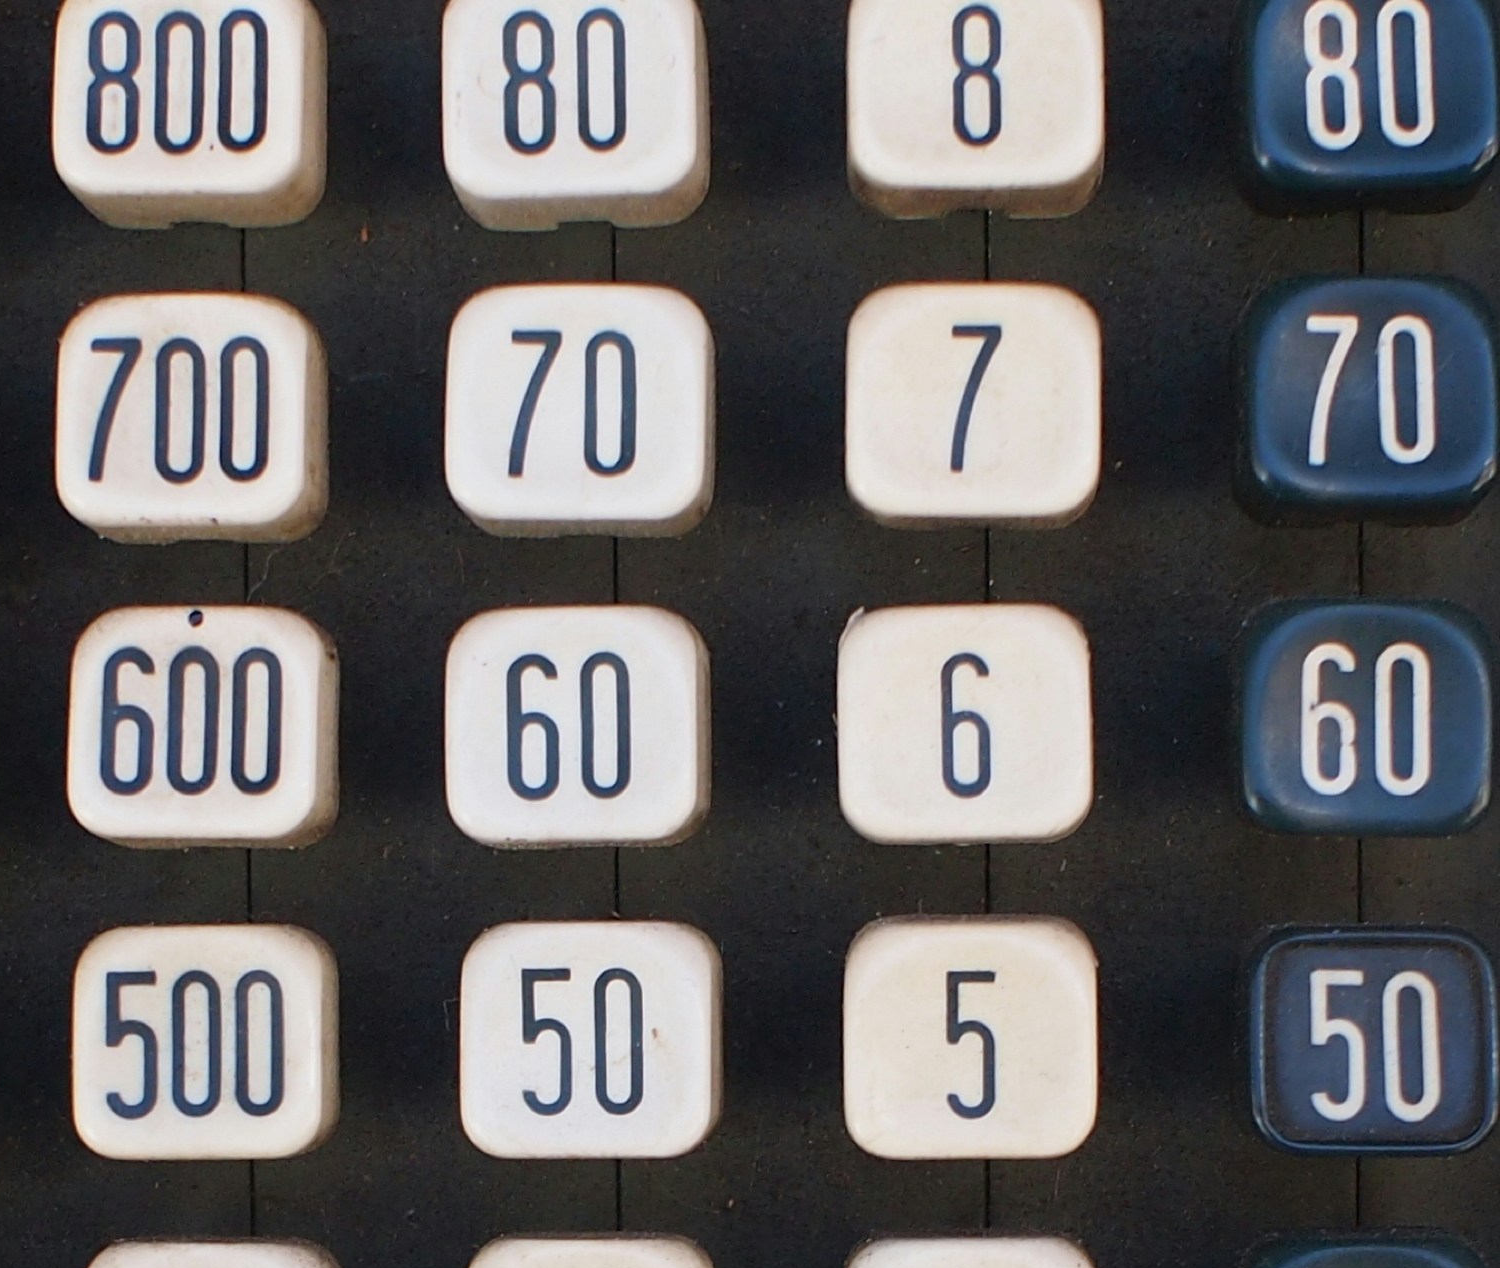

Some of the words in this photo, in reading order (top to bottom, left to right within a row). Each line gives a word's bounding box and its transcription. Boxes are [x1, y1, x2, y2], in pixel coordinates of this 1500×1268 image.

[85, 9, 269, 155] 800
[502, 8, 627, 155] 80
[952, 4, 1002, 147] 8
[1301, 0, 1436, 151] 80
[88, 336, 270, 485] 700
[507, 330, 637, 477] 70
[950, 324, 1003, 472] 7
[1305, 313, 1436, 467] 70
[99, 645, 283, 796] 600
[506, 651, 631, 801] 60
[940, 652, 992, 798] 6
[1299, 641, 1432, 797] 60
[105, 969, 285, 1120] 500
[520, 967, 644, 1116] 50
[946, 970, 996, 1119] 5
[1309, 968, 1442, 1123] 50
